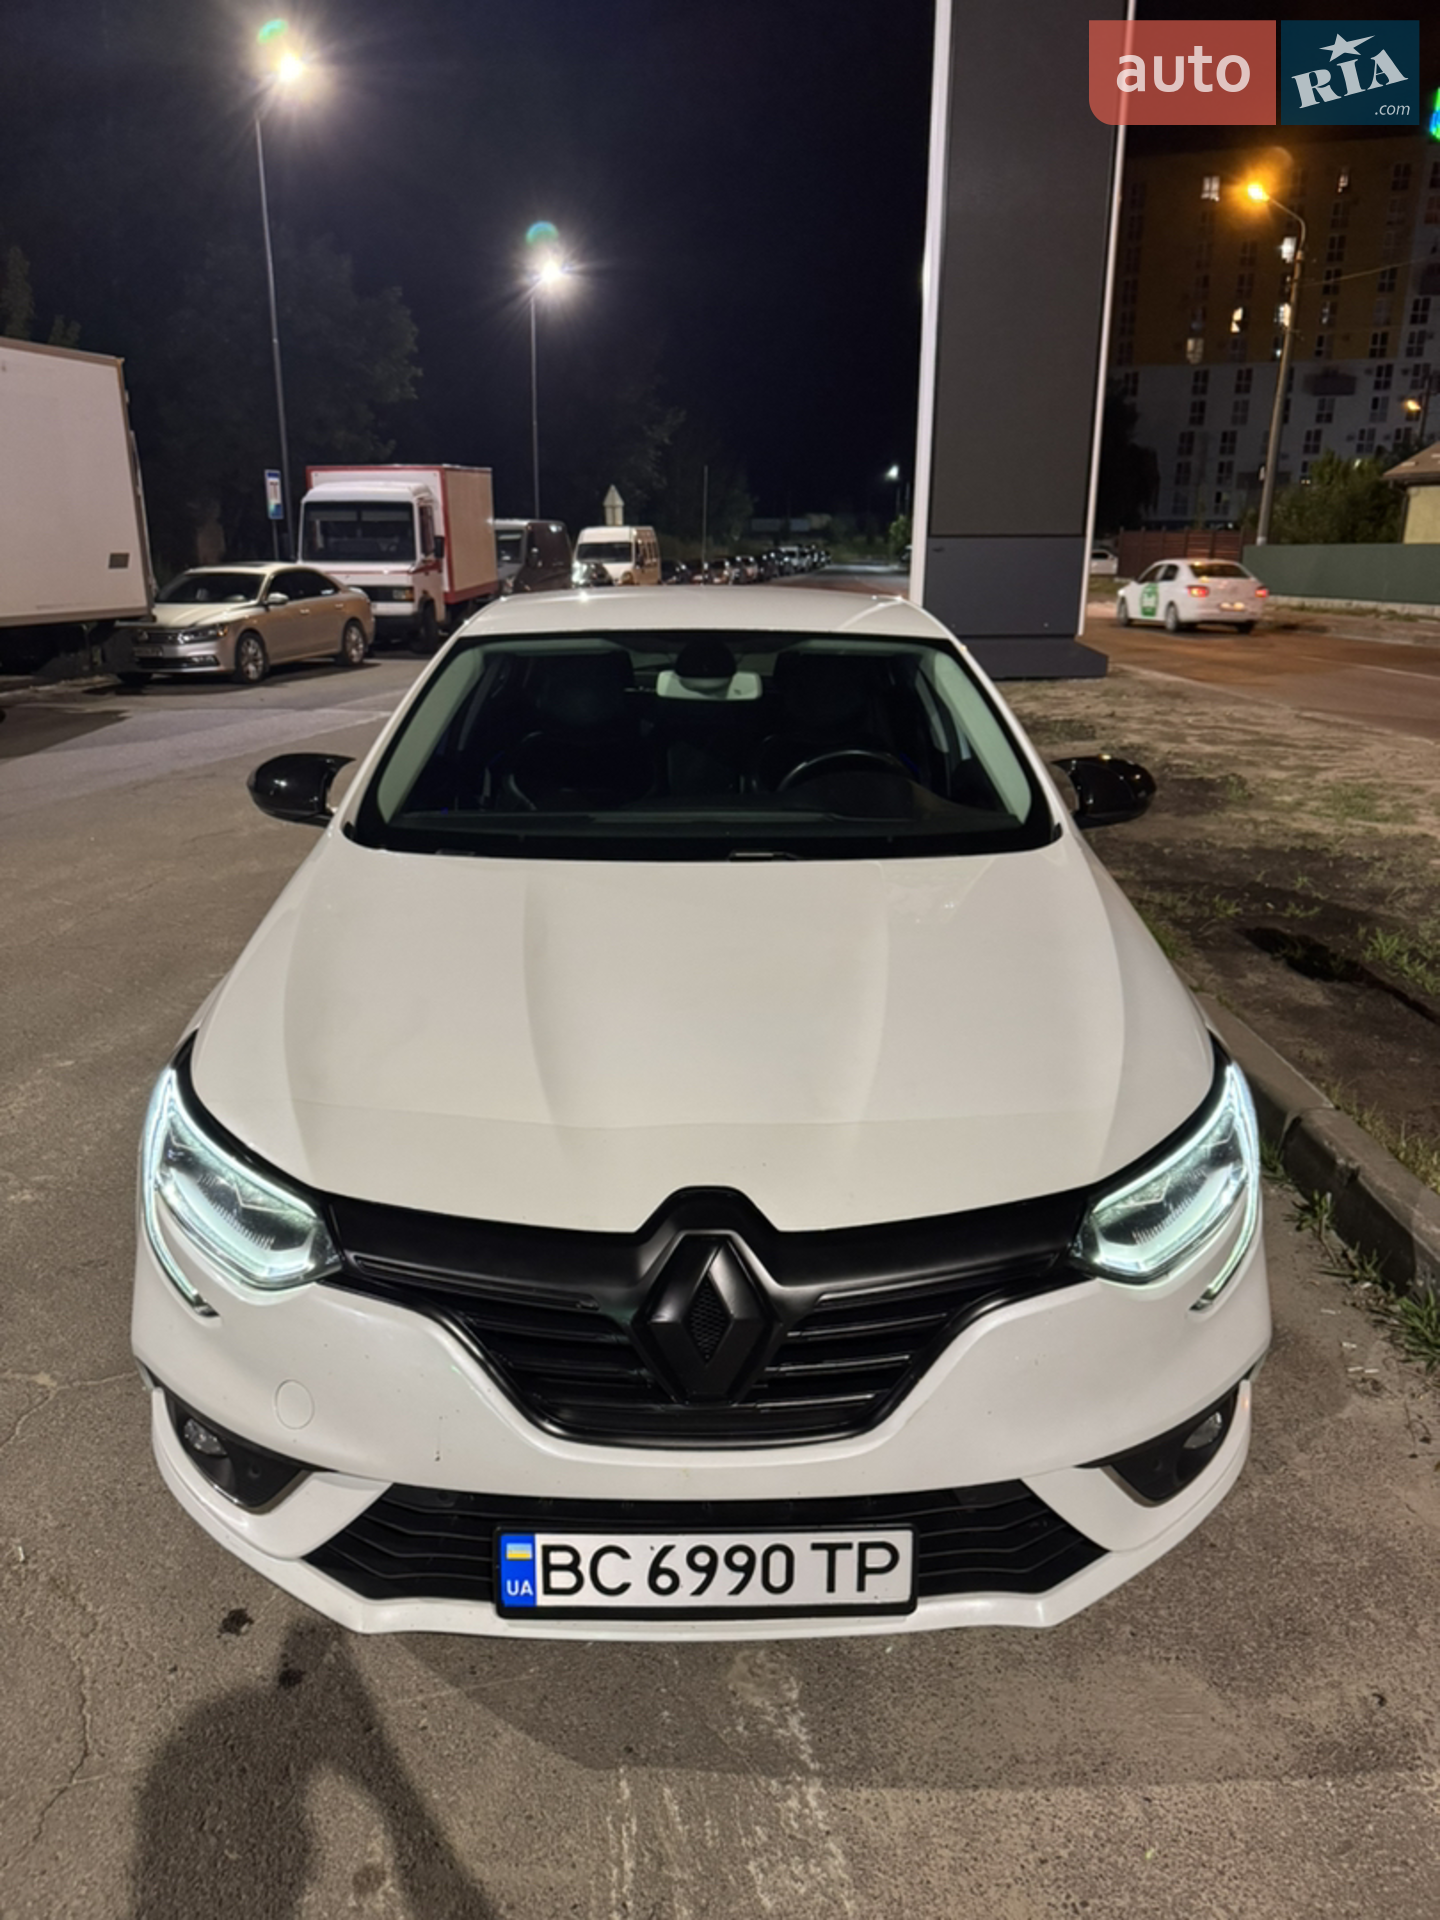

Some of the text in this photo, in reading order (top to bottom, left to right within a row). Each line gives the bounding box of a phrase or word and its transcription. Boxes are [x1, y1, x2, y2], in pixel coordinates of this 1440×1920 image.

[541, 1541, 900, 1596] BC 6990 TP
[506, 1579, 534, 1597] UA
